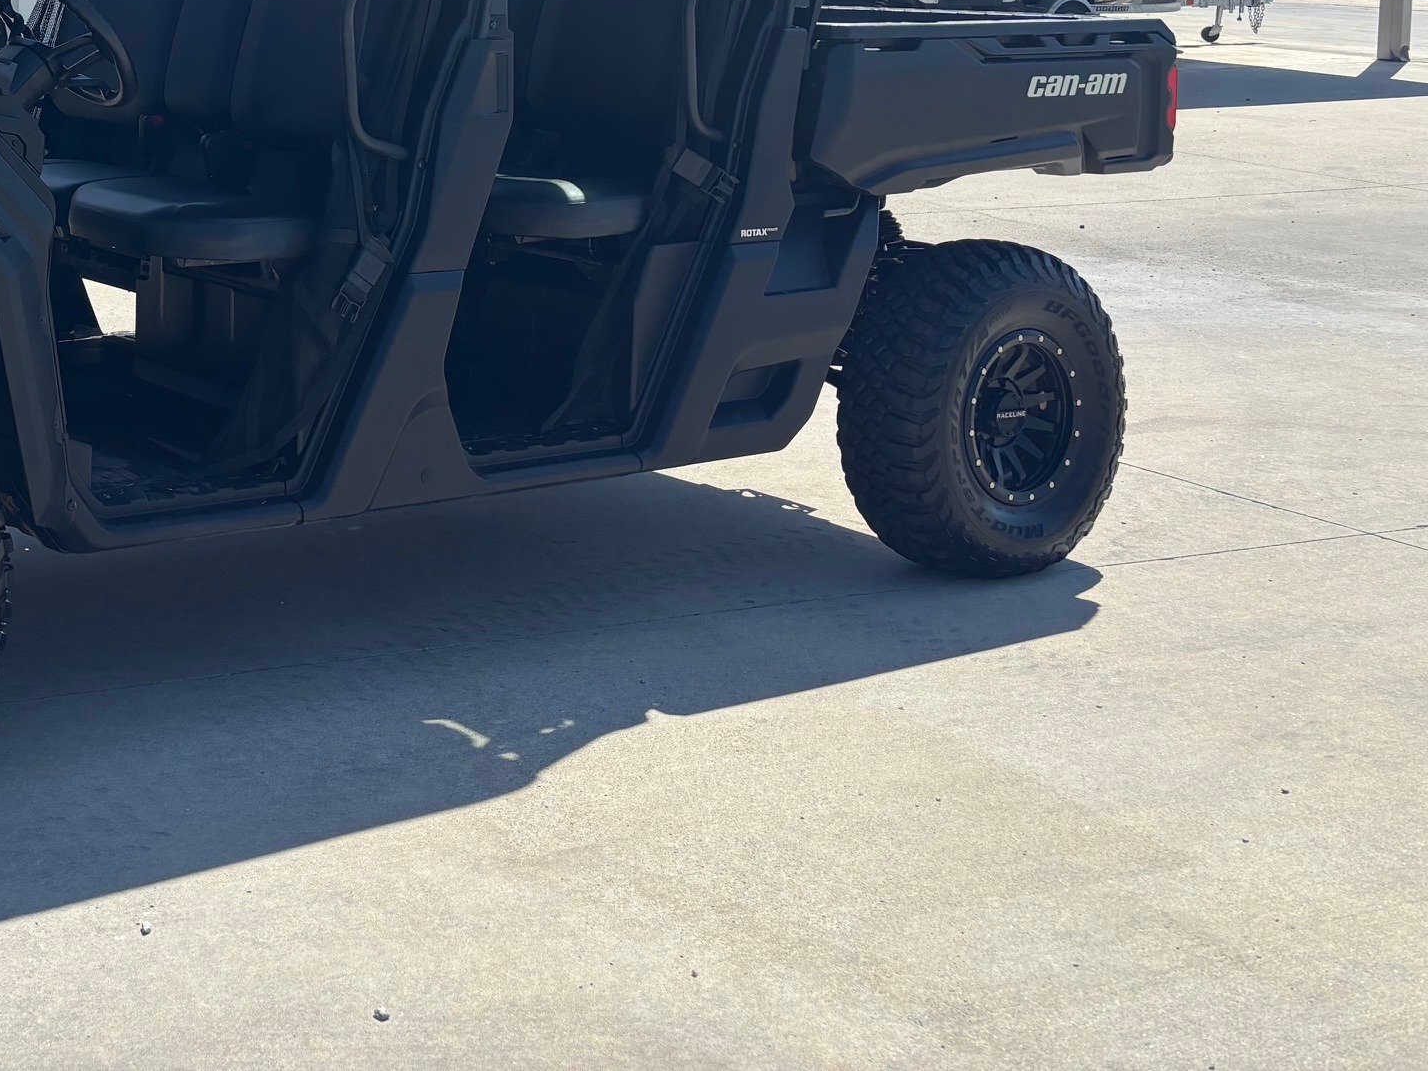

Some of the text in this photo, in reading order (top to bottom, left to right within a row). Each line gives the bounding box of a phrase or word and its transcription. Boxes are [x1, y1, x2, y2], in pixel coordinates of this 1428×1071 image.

[1027, 73, 1127, 98] can-am
[741, 228, 767, 237] ROTAX
[997, 410, 1026, 419] RACELINE
